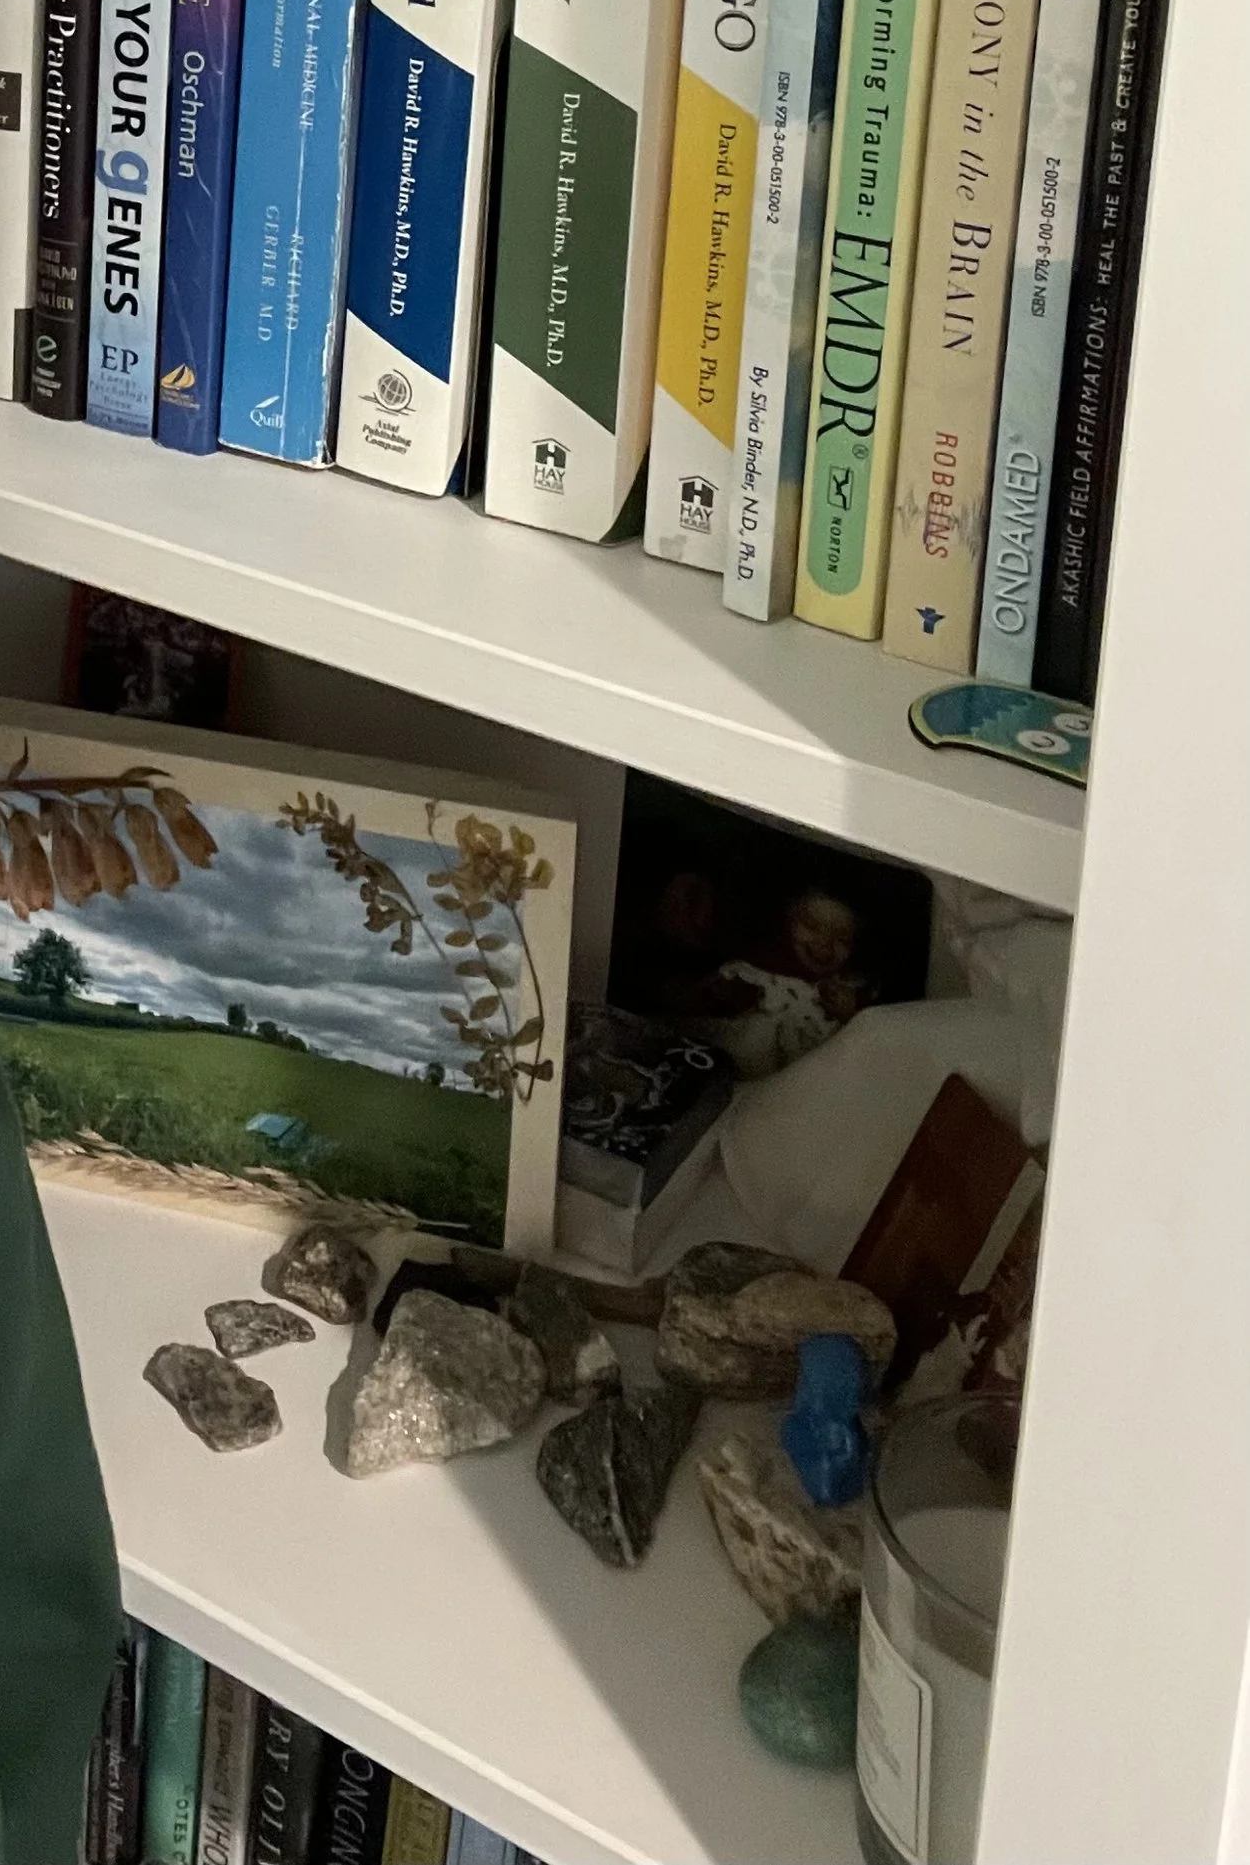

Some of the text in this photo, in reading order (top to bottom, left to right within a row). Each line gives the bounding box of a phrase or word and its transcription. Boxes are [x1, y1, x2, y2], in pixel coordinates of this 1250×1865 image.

[111, 2, 151, 138] YOUR
[177, 50, 205, 178] Oschman
[300, 44, 319, 133] MEDICINE
[1115, 39, 1137, 110] CREATE
[43, 12, 77, 220] Practitioners
[766, 71, 791, 225] ISBN 978-3-00-051500-2
[857, 104, 890, 217] Trauma:
[963, 102, 994, 134] in
[389, 57, 424, 317] David R. Hawkins, M.D., Ph.D.
[956, 148, 989, 201] the
[1106, 140, 1126, 186] PAST
[546, 92, 581, 367] David R. Hawkins, M.D., Ph.D.
[1101, 193, 1121, 230] THE
[284, 233, 305, 331] RICHARD
[698, 123, 737, 407] David R. Hawkins, M.D., Ph.D.
[942, 218, 993, 355] BRAIN
[1096, 238, 1116, 286] HEAL
[100, 343, 139, 375] EP
[1074, 295, 1108, 464] AFFIRMATIONS:
[249, 408, 285, 430] Quill
[534, 464, 566, 483] HAY
[680, 502, 714, 522] HAY
[737, 366, 769, 581] By Silvia Binder, N.D., Ph.D.
[924, 431, 958, 559] ROBBINS
[1068, 467, 1092, 520] FIELD
[827, 517, 843, 574] NORTON
[1060, 524, 1087, 609] AKASHIC
